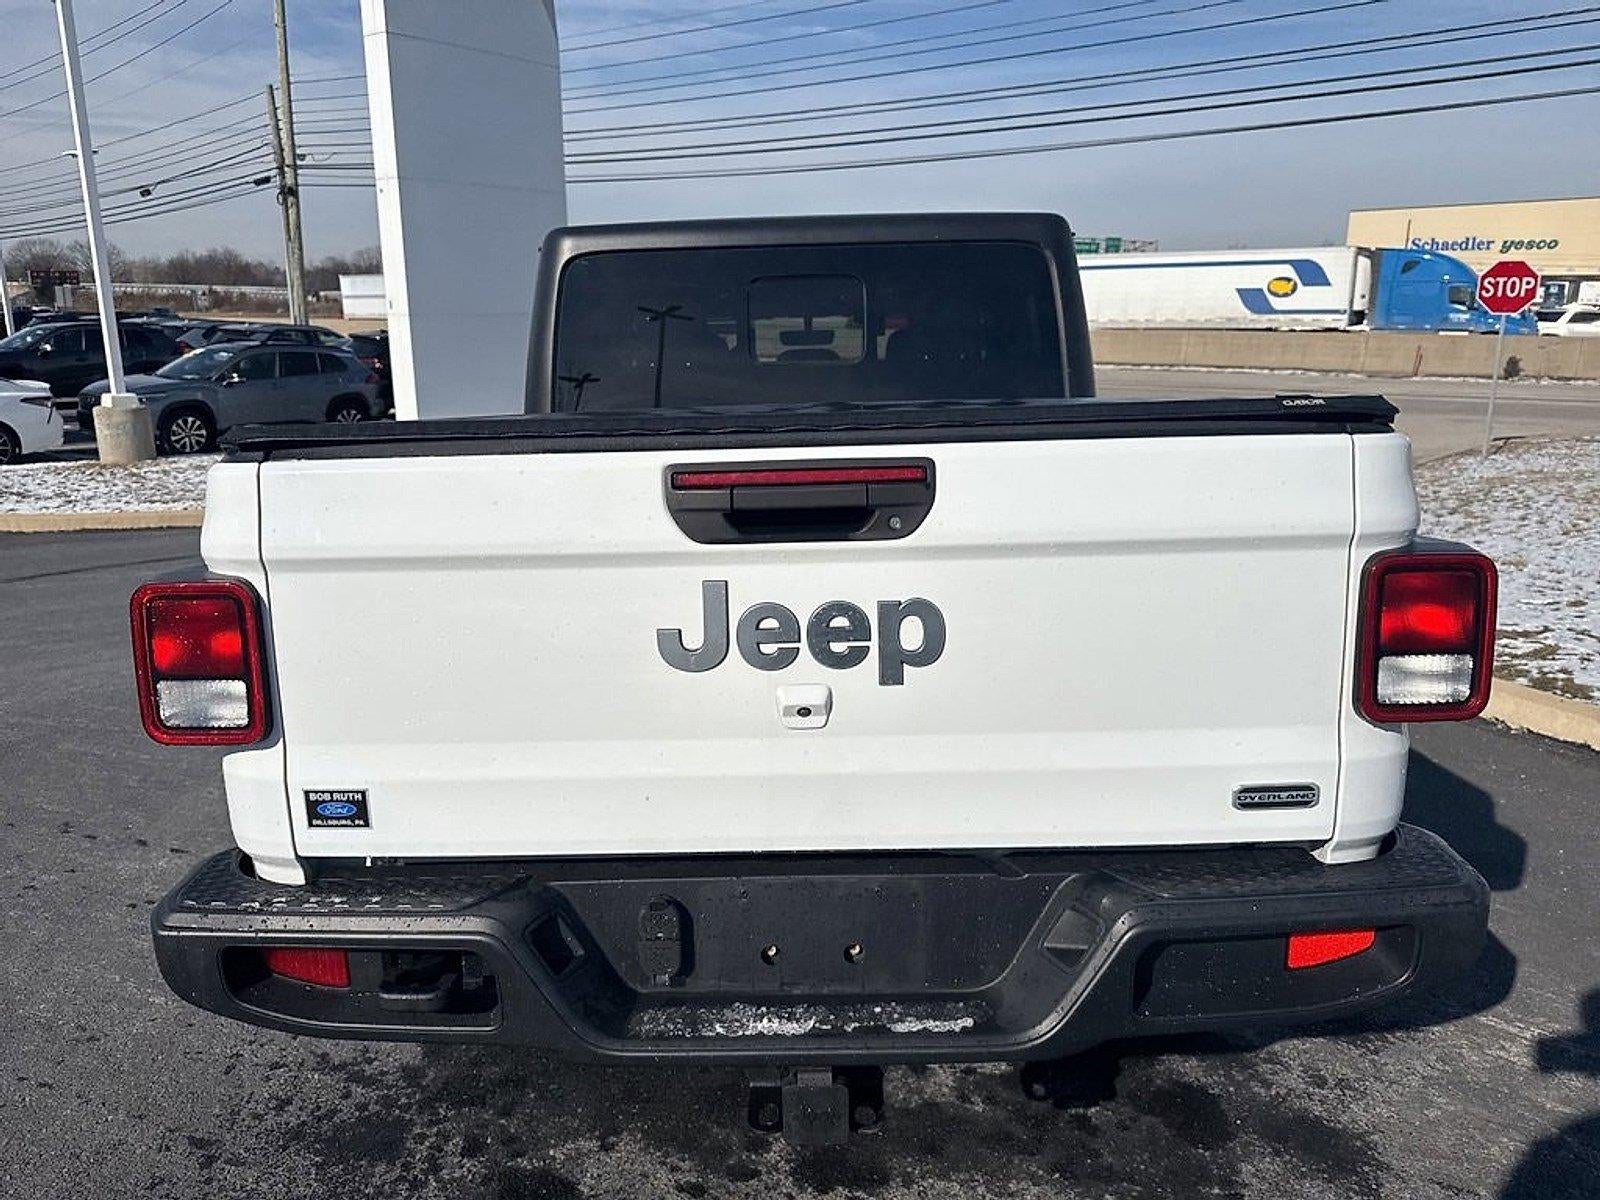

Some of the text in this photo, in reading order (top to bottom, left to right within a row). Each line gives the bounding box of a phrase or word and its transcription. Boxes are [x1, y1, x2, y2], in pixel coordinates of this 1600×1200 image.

[1410, 237, 1558, 253] Schaedler yesco
[1481, 276, 1535, 298] STOP
[656, 579, 946, 686] Jeep
[309, 792, 362, 801] BOB RUTH
[1237, 792, 1316, 801] OVERLAND
